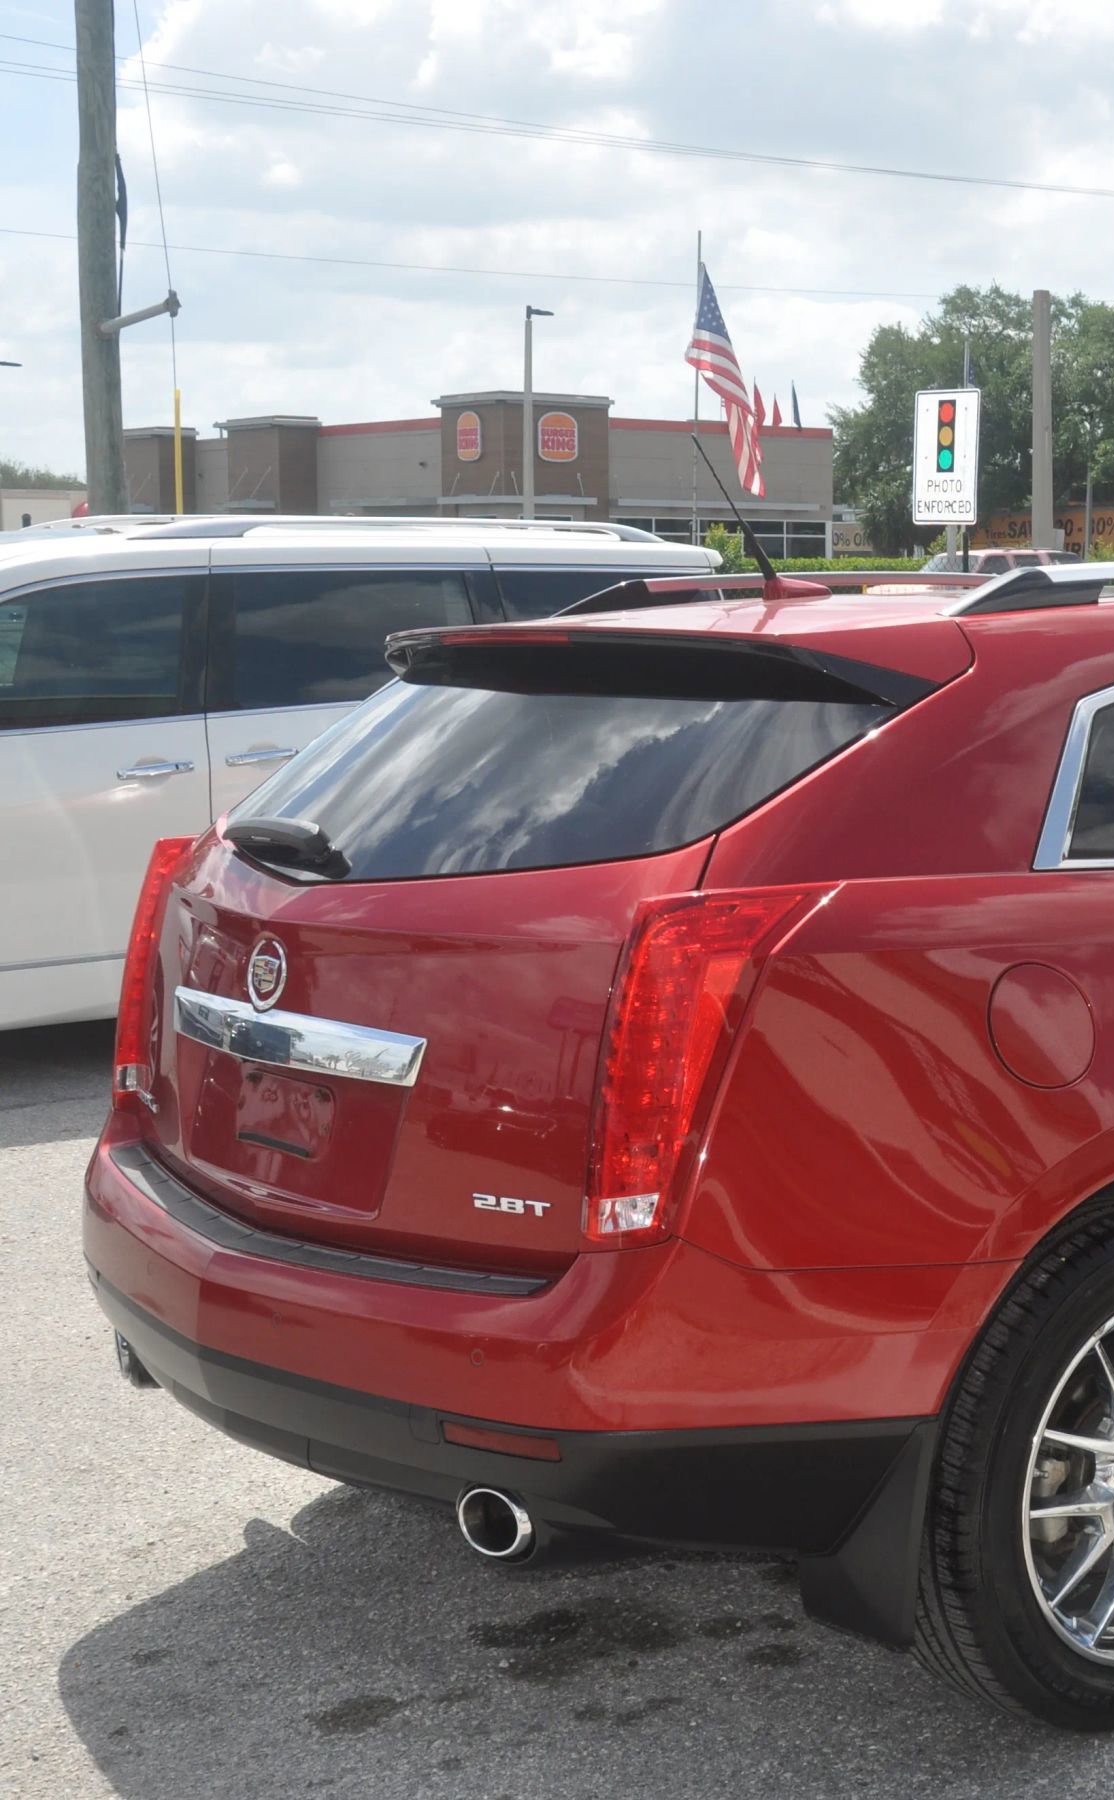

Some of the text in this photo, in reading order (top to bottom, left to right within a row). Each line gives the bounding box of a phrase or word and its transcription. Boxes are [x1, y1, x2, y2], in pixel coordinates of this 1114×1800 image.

[541, 438, 576, 451] KING
[927, 479, 962, 493] PHOTO
[917, 500, 972, 514] ENFORCED
